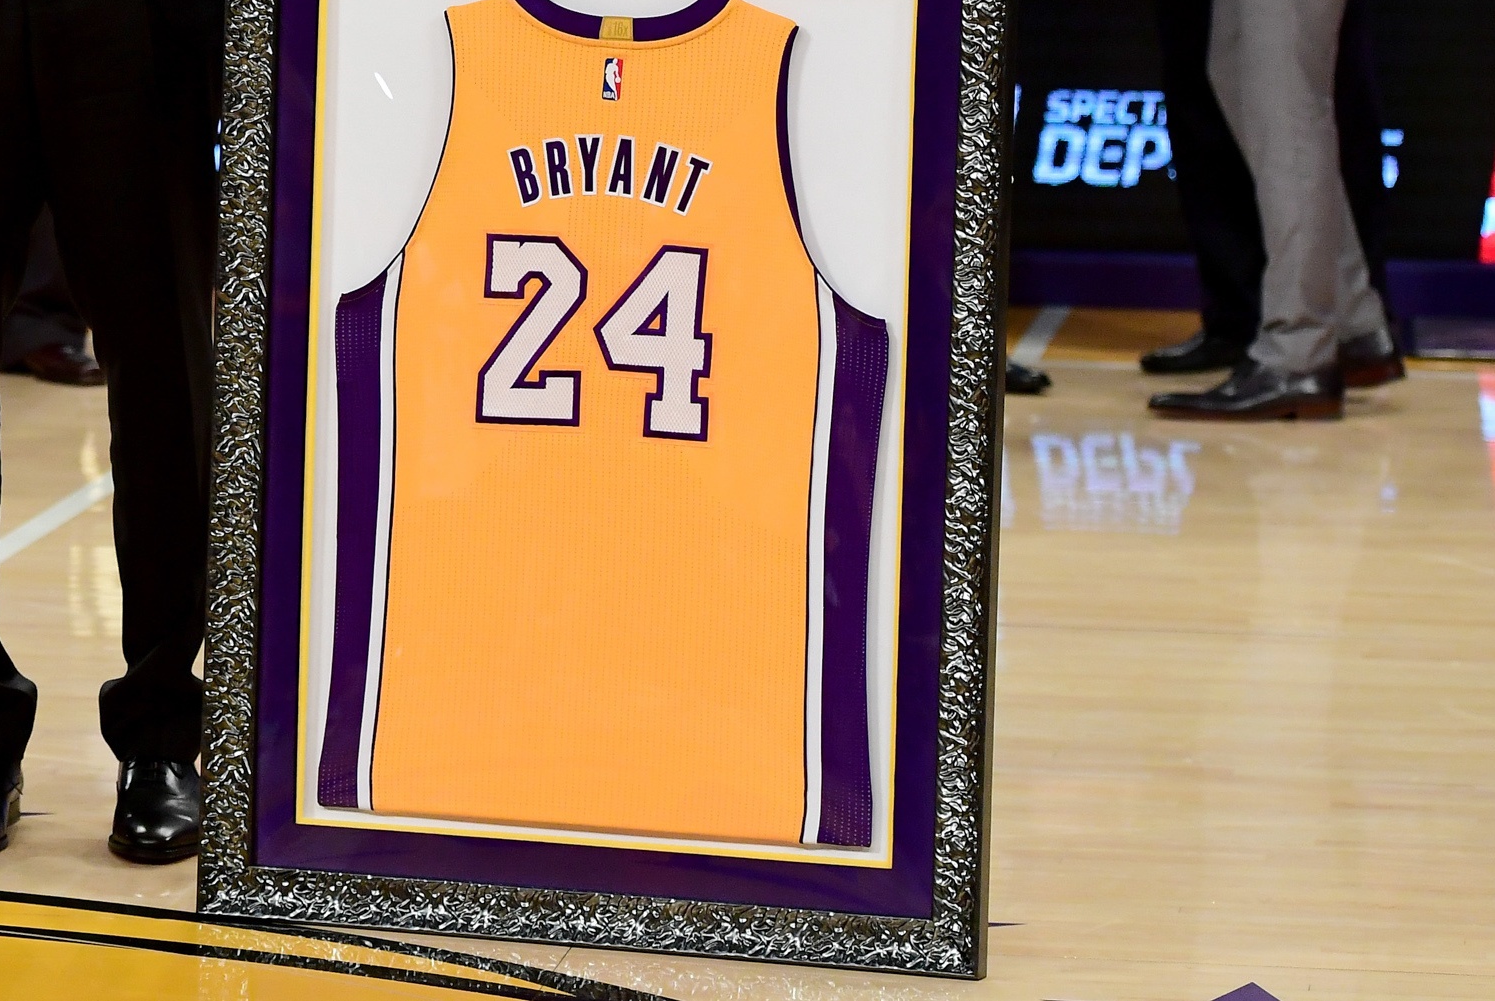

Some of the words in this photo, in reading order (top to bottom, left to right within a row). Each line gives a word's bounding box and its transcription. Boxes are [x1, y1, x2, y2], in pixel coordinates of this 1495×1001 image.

[509, 134, 710, 215] BRYANT
[1032, 123, 1177, 188] DEP
[475, 234, 713, 441] 24
